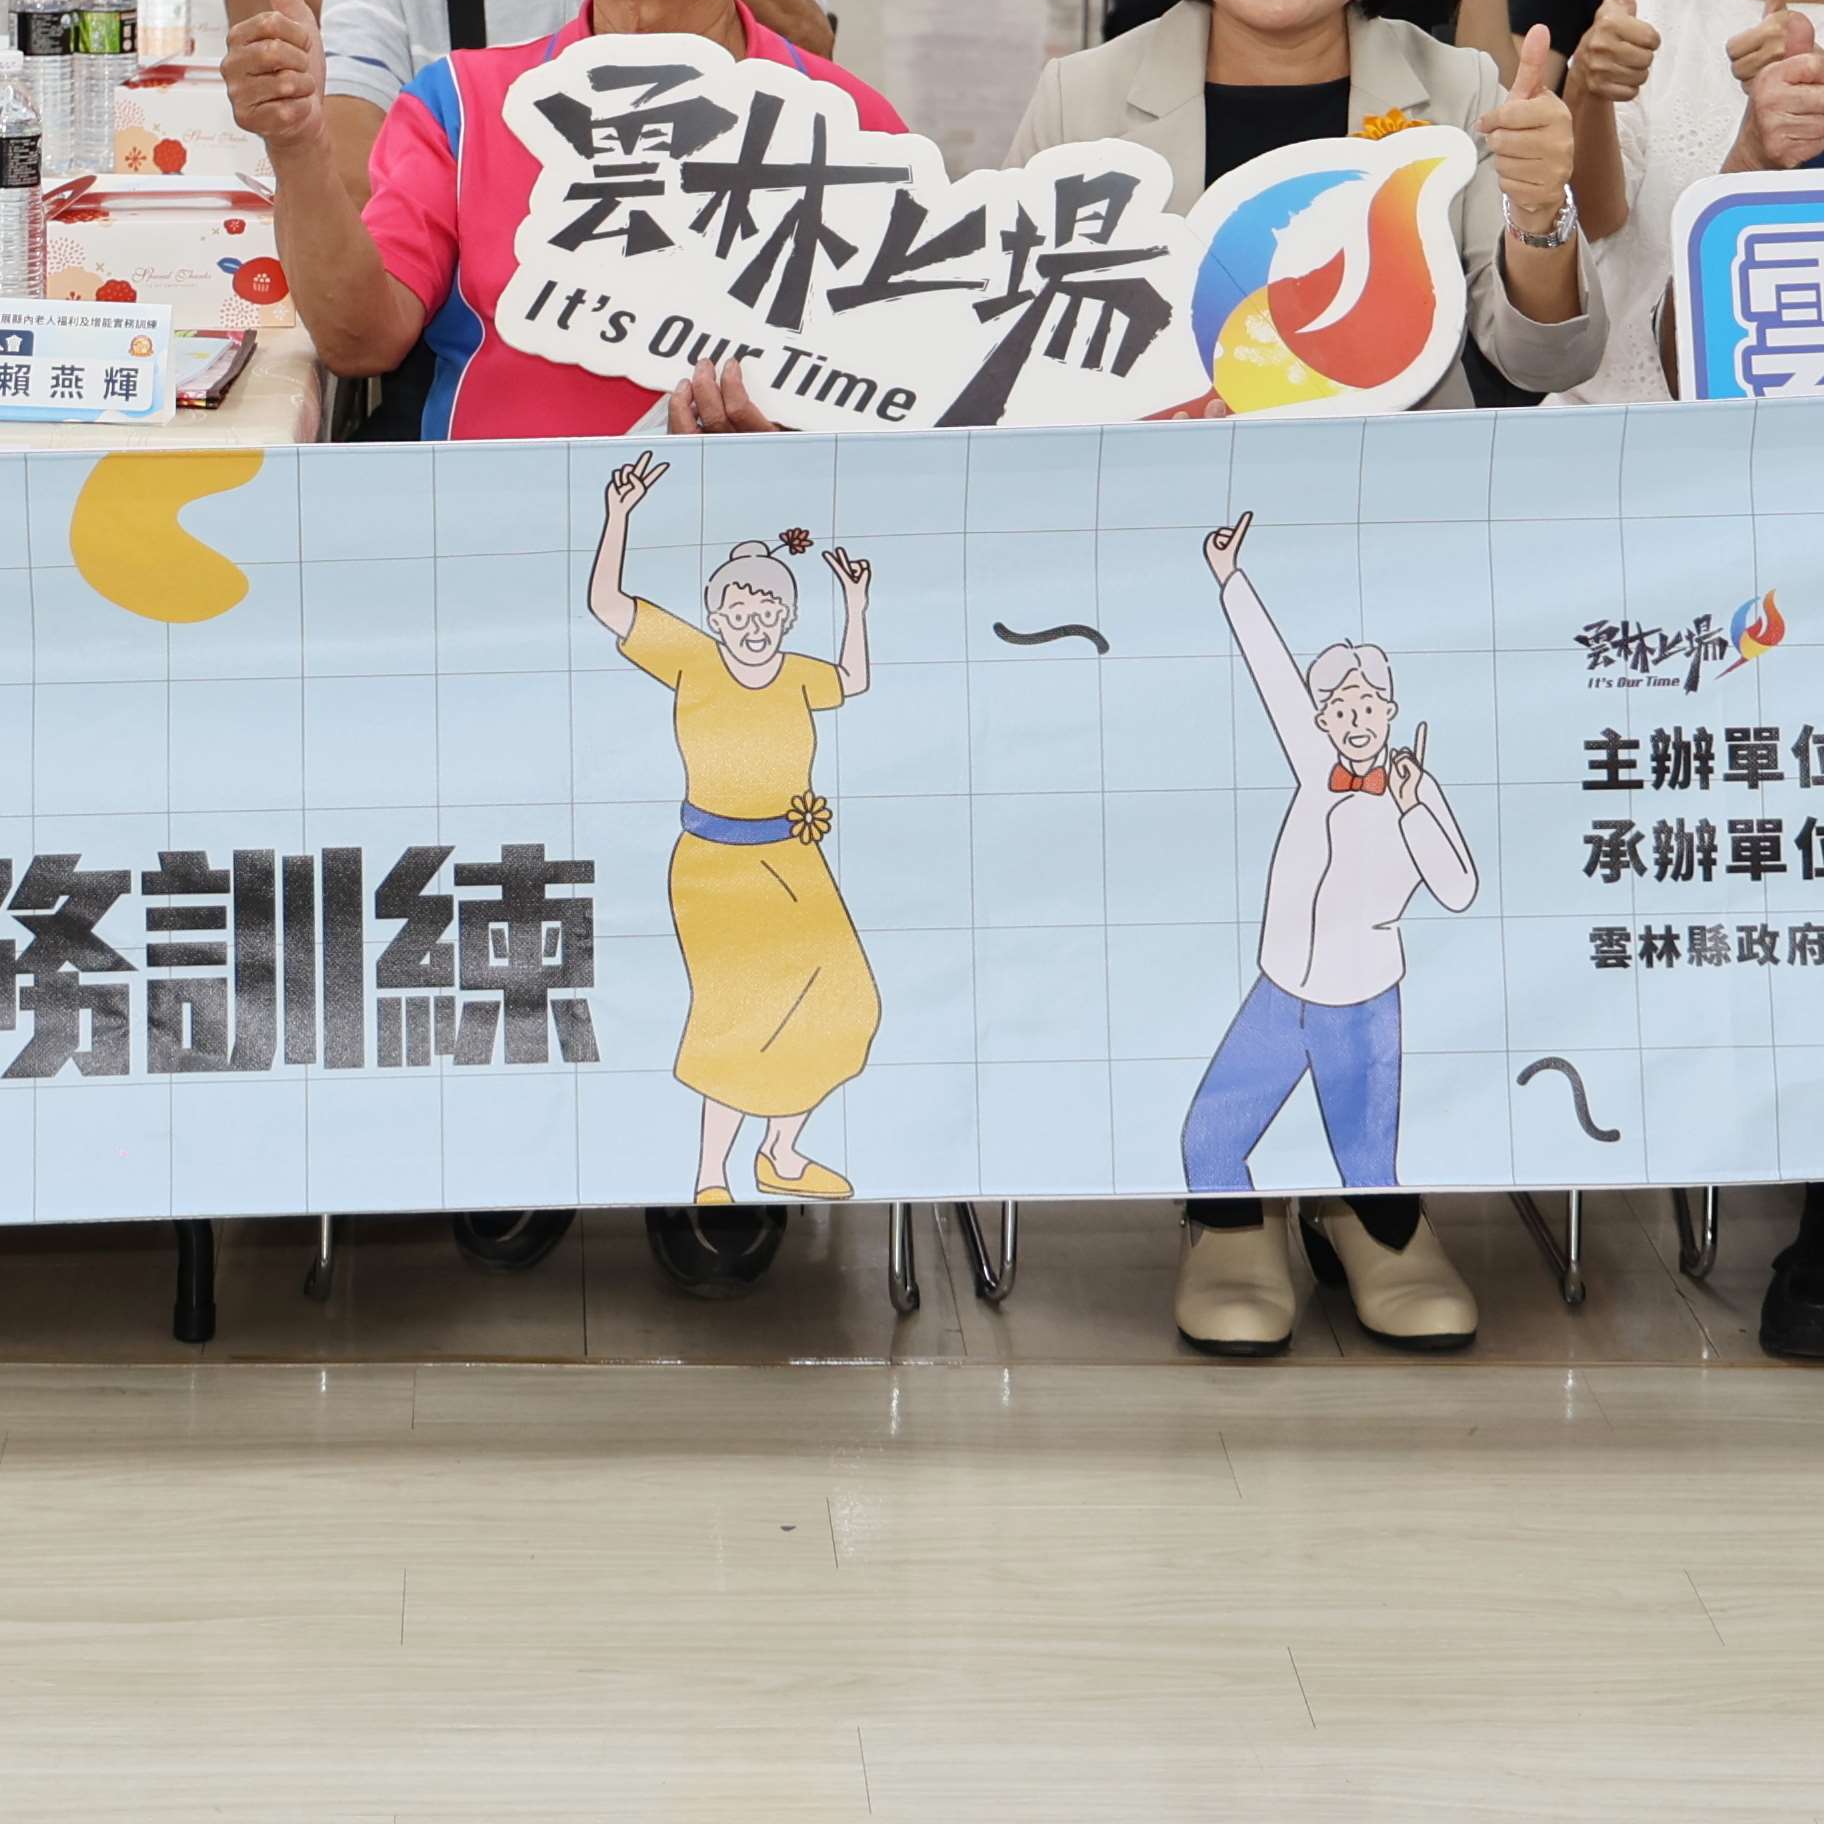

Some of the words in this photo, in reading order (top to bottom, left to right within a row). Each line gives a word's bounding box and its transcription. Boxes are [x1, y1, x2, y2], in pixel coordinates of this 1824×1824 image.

[533, 64, 1173, 428] 雲林上場
[524, 279, 637, 344] It's
[647, 314, 765, 367] Our
[770, 345, 917, 423] Time
[1573, 614, 1729, 695] 雲林上場
[1587, 676, 1613, 689] It's
[1617, 676, 1643, 689] Our
[1646, 676, 1680, 688] Time
